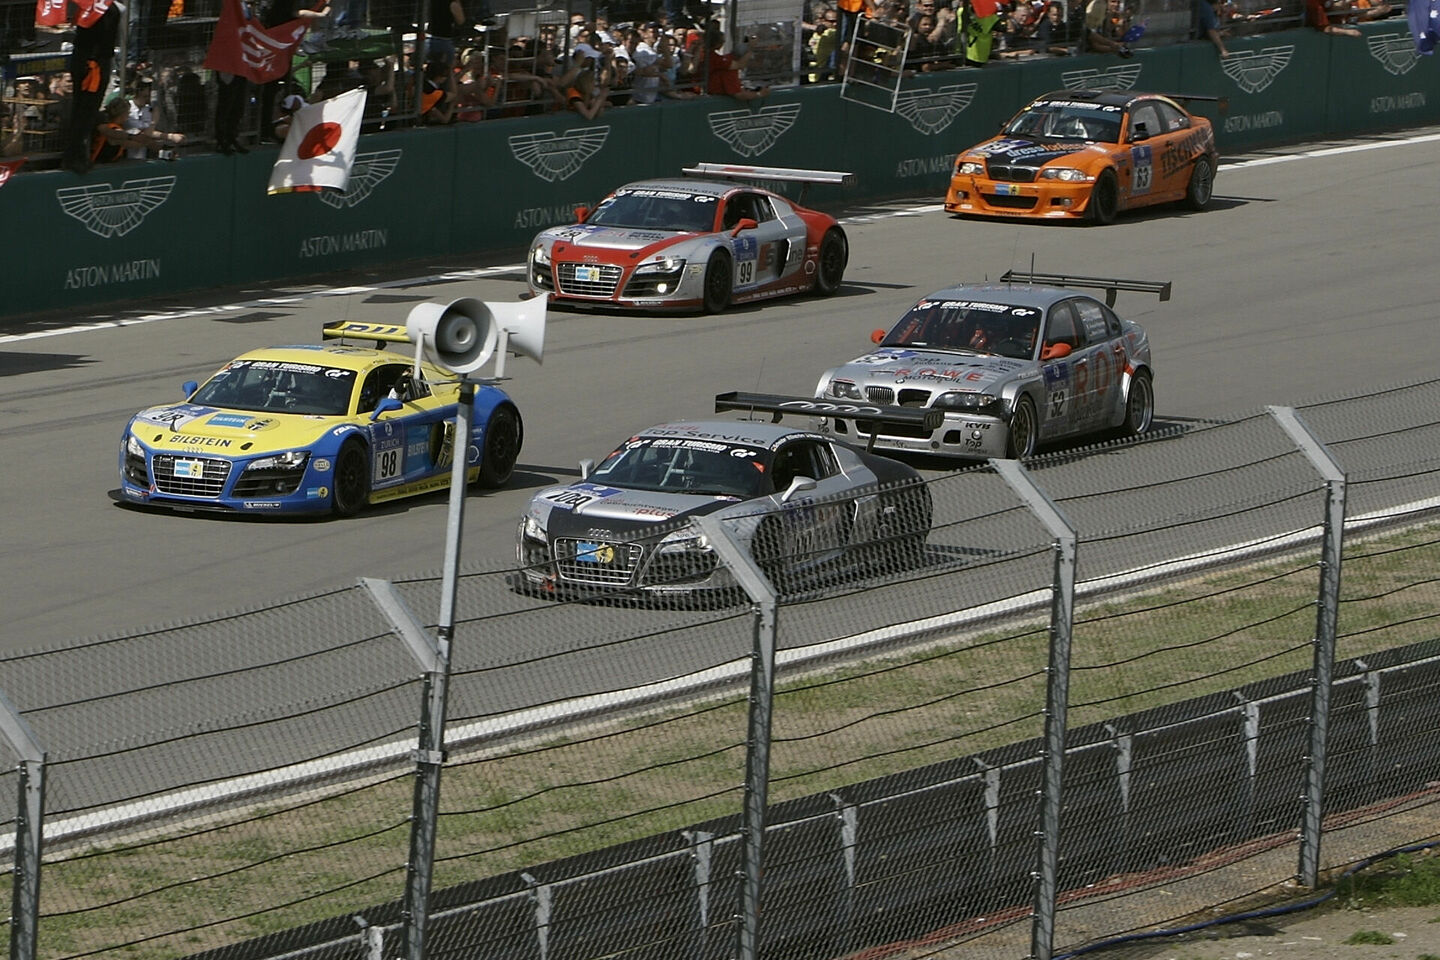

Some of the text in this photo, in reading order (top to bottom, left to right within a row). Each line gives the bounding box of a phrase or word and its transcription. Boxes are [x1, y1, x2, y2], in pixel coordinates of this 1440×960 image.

[896, 159, 929, 179] ASTON
[513, 207, 551, 231] ASTON
[299, 227, 388, 259] ASTON MARTIN
[64, 258, 160, 290] ASTON MARTIN
[740, 262, 753, 283] 99
[251, 360, 277, 369] GRAN
[278, 362, 322, 373] TURISMO
[169, 434, 233, 448] BILSTEIN
[649, 428, 679, 436] Top
[693, 430, 766, 445] Service
[652, 439, 683, 447] GRAN
[684, 440, 728, 451] TURISMO
[381, 450, 397, 478] 98
